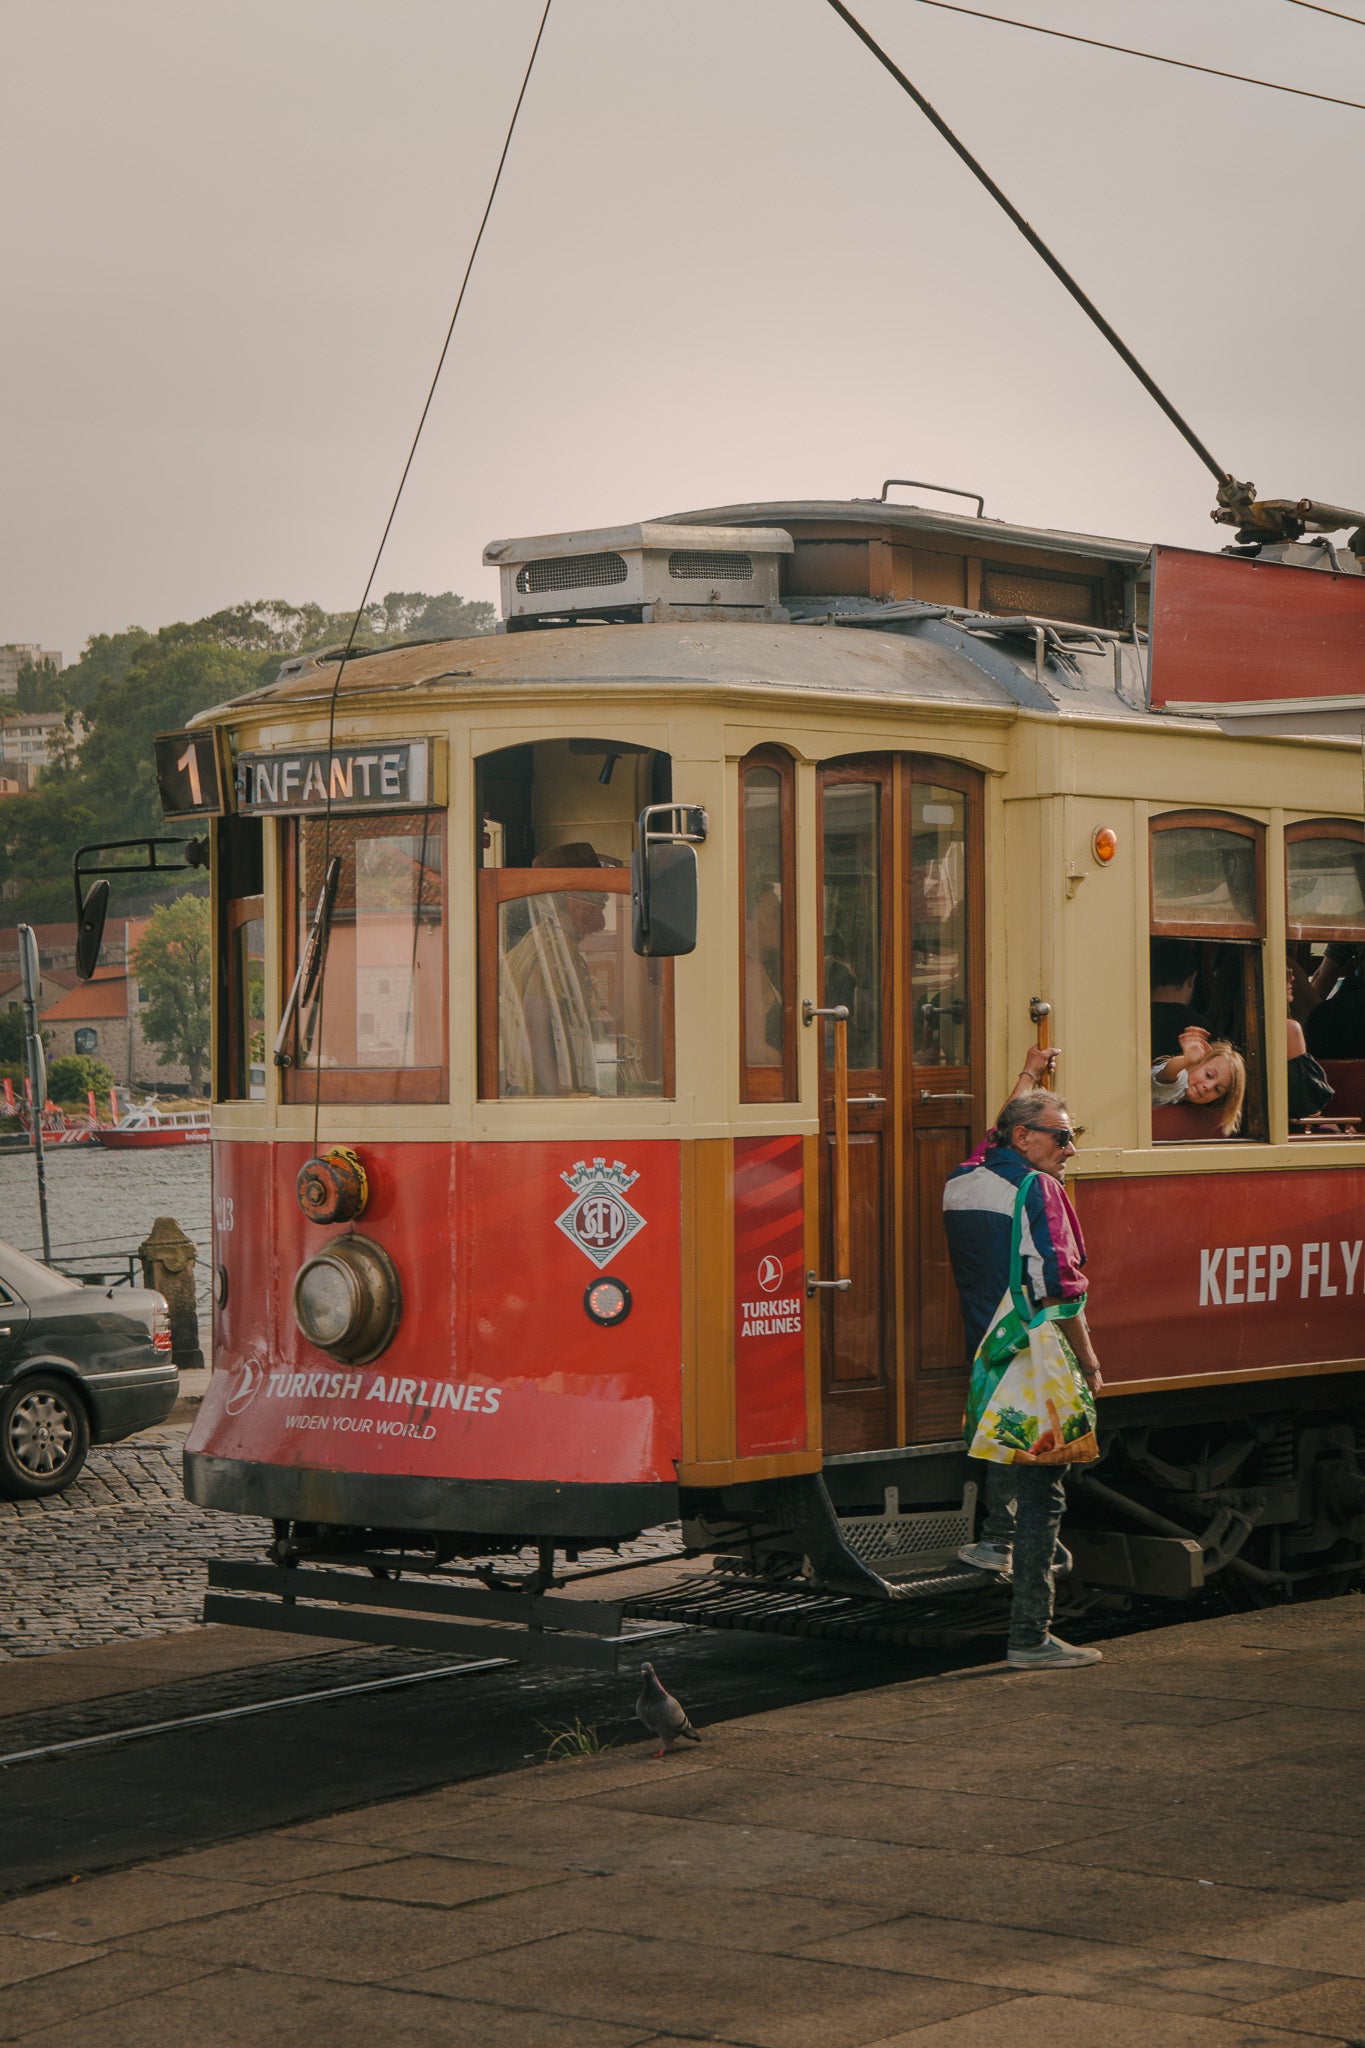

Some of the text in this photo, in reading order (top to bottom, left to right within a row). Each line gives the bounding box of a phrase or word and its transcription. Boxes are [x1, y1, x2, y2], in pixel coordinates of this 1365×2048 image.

[177, 744, 202, 804] 1
[1199, 1240, 1365, 1306] KEEP FLY
[742, 1299, 801, 1318] TURKISH
[742, 1317, 801, 1337] AIRLINES
[265, 1373, 502, 1414] TURKISH AIRLINES
[285, 1415, 437, 1441] WIDEN YOUR WORLD
